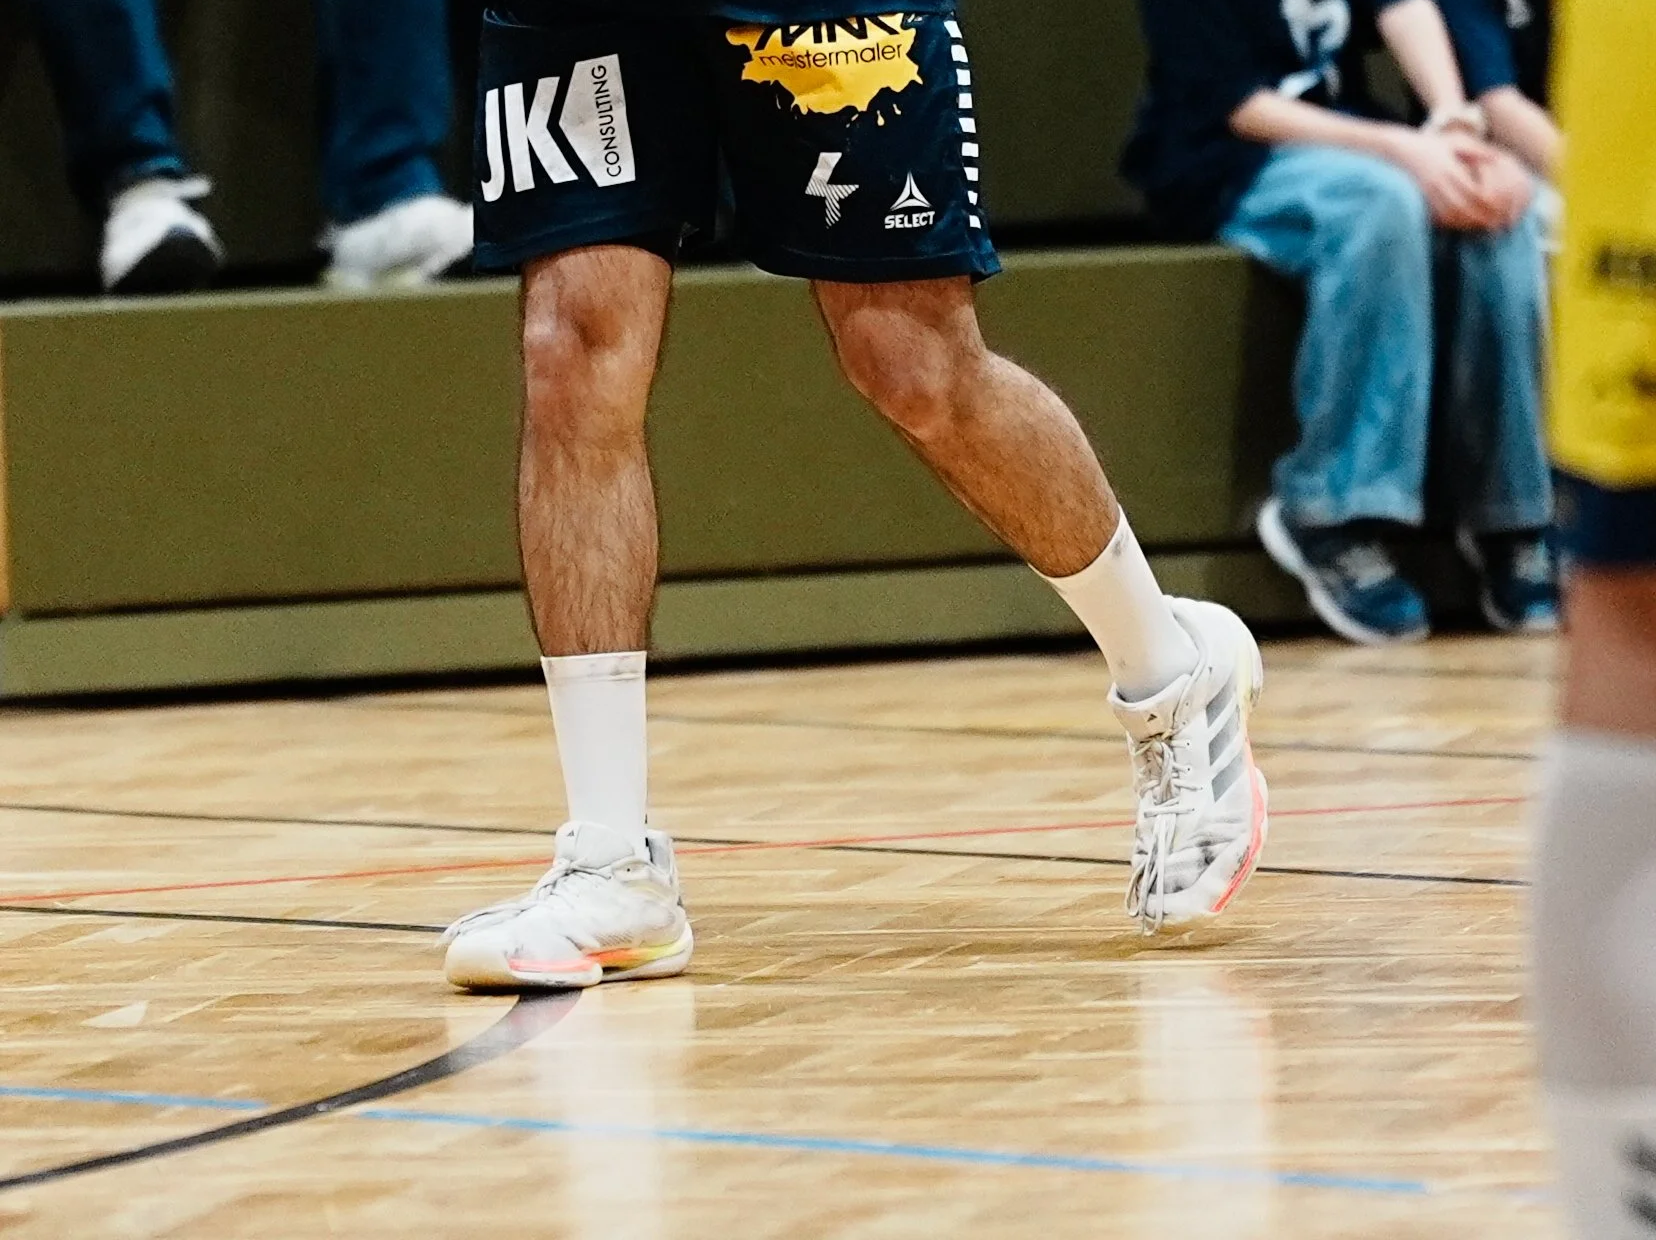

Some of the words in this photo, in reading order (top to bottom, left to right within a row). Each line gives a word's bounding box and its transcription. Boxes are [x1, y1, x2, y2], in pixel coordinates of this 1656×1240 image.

[758, 42, 903, 70] meistermaler
[480, 76, 579, 203] JK
[591, 64, 622, 178] CONSULTING
[884, 210, 936, 230] SELECT
